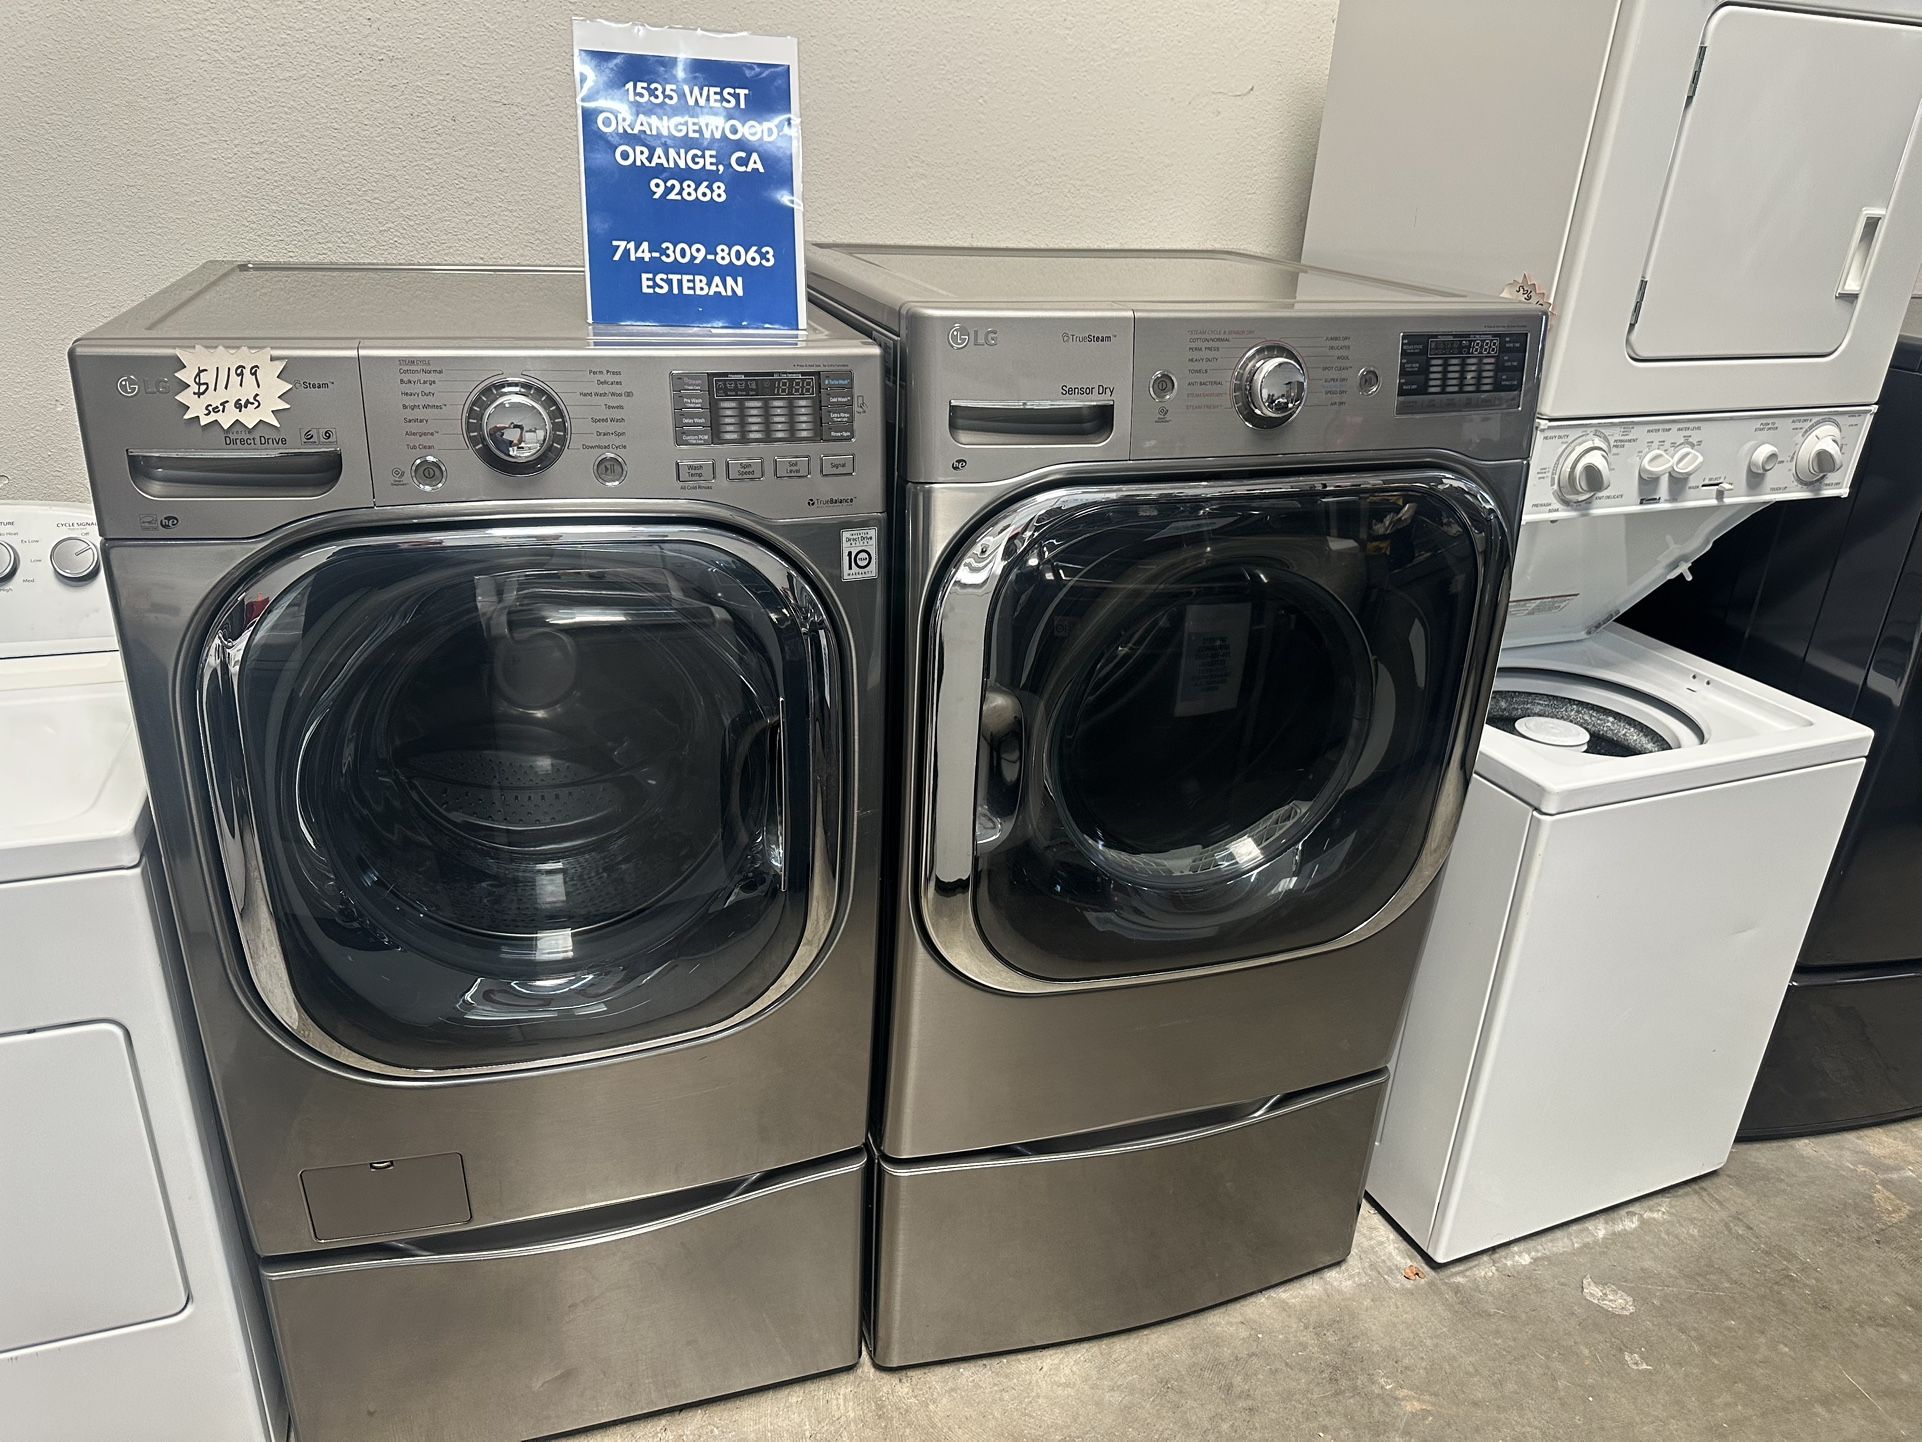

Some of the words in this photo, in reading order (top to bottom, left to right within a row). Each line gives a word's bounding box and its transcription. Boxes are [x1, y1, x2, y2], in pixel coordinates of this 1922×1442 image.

[624, 81, 678, 105] 1535
[683, 86, 749, 109] WEST
[596, 111, 778, 142] ORANGEWOOD
[614, 144, 724, 174] ORANGE,
[730, 152, 765, 173] CA
[649, 178, 727, 203] 92868
[611, 240, 775, 267] 714-309-8063
[641, 273, 744, 297] ESTEBAN
[974, 329, 998, 346] LG
[193, 364, 261, 398] $1199
[399, 378, 437, 386] Bulky/Large
[421, 390, 436, 398] Duty
[1061, 384, 1095, 396] Sensor
[1098, 384, 1115, 397] Dry
[403, 417, 429, 425] Sanitary
[224, 436, 256, 445] Direct
[259, 435, 287, 445] Drive
[596, 430, 626, 438] Drain+Spin
[611, 443, 627, 452] Cycle
[740, 462, 752, 470] Spin
[830, 462, 847, 470] Signal
[737, 469, 755, 477] Speed
[847, 549, 873, 571] 10
